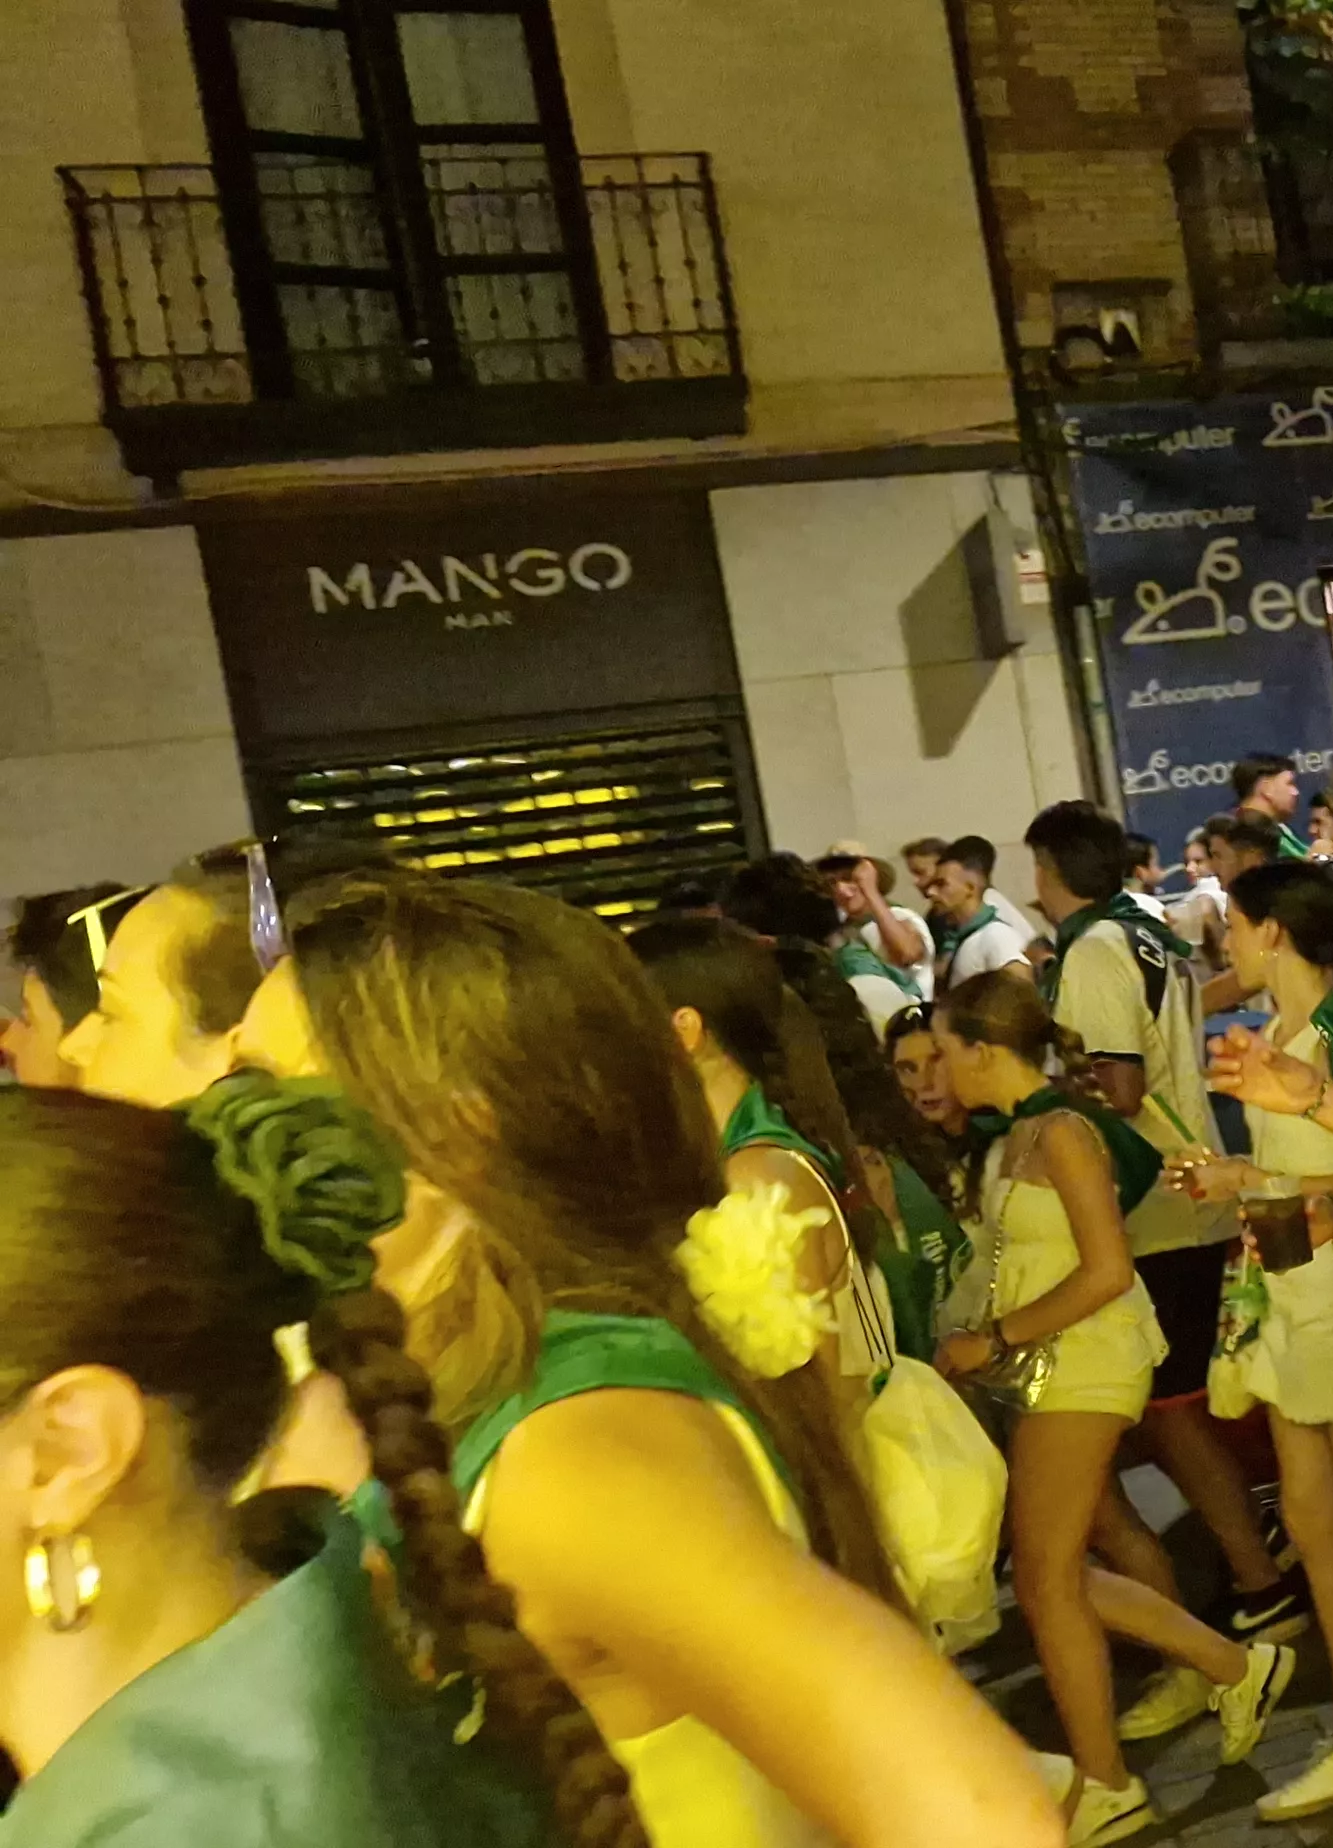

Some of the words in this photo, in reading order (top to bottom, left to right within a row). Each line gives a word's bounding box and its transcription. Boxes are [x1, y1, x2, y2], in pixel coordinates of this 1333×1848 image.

[1133, 505, 1256, 529] ecomputer
[306, 542, 632, 615] MANGO
[444, 610, 513, 632] MAN
[1161, 680, 1262, 704] ecomputer
